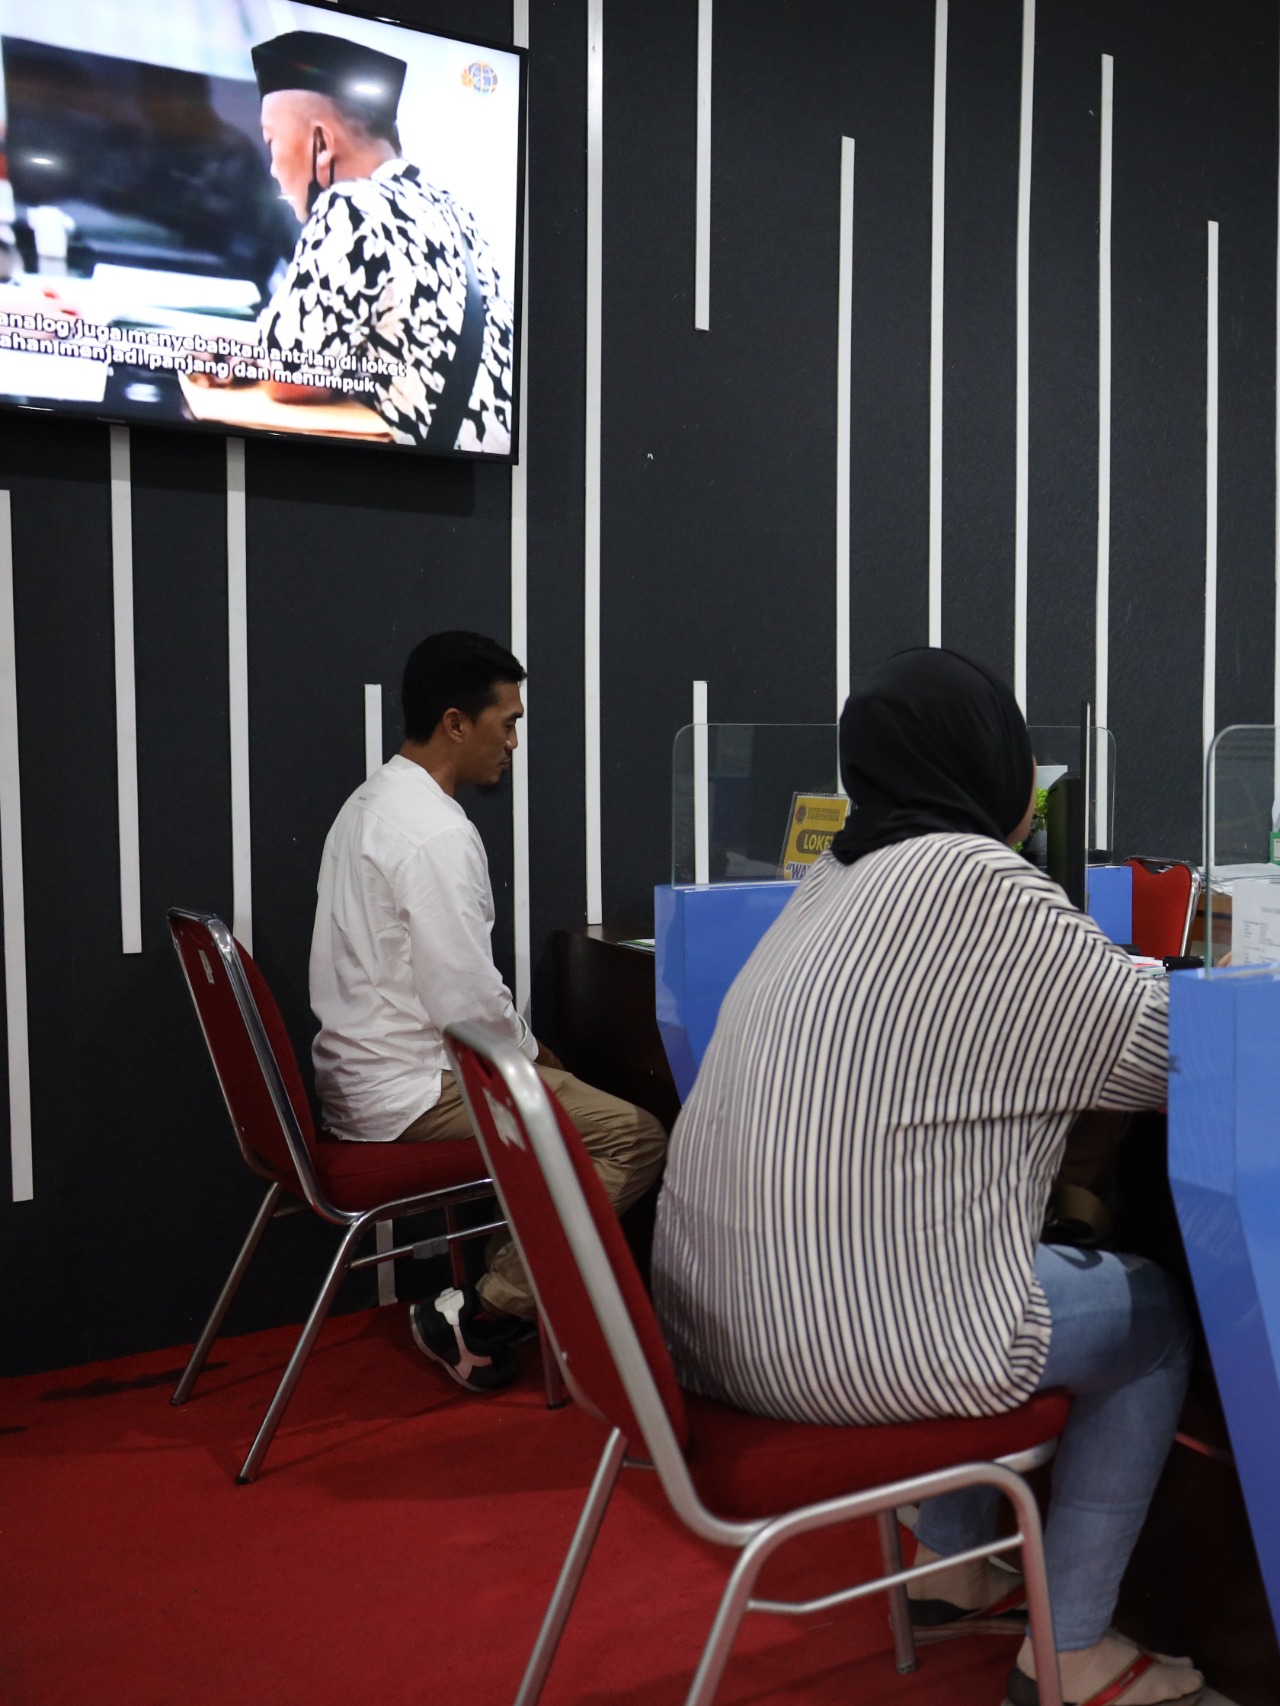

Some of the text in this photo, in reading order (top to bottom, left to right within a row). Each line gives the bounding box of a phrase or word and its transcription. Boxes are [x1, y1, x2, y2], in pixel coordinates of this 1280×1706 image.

[0, 312, 407, 377] analog juga menyebabkan antrian di loket
[59, 342, 144, 365] menjadi
[149, 352, 229, 378] panjang
[234, 362, 269, 380] dan
[274, 370, 376, 393] menumpuk
[803, 833, 834, 850] LOKE
